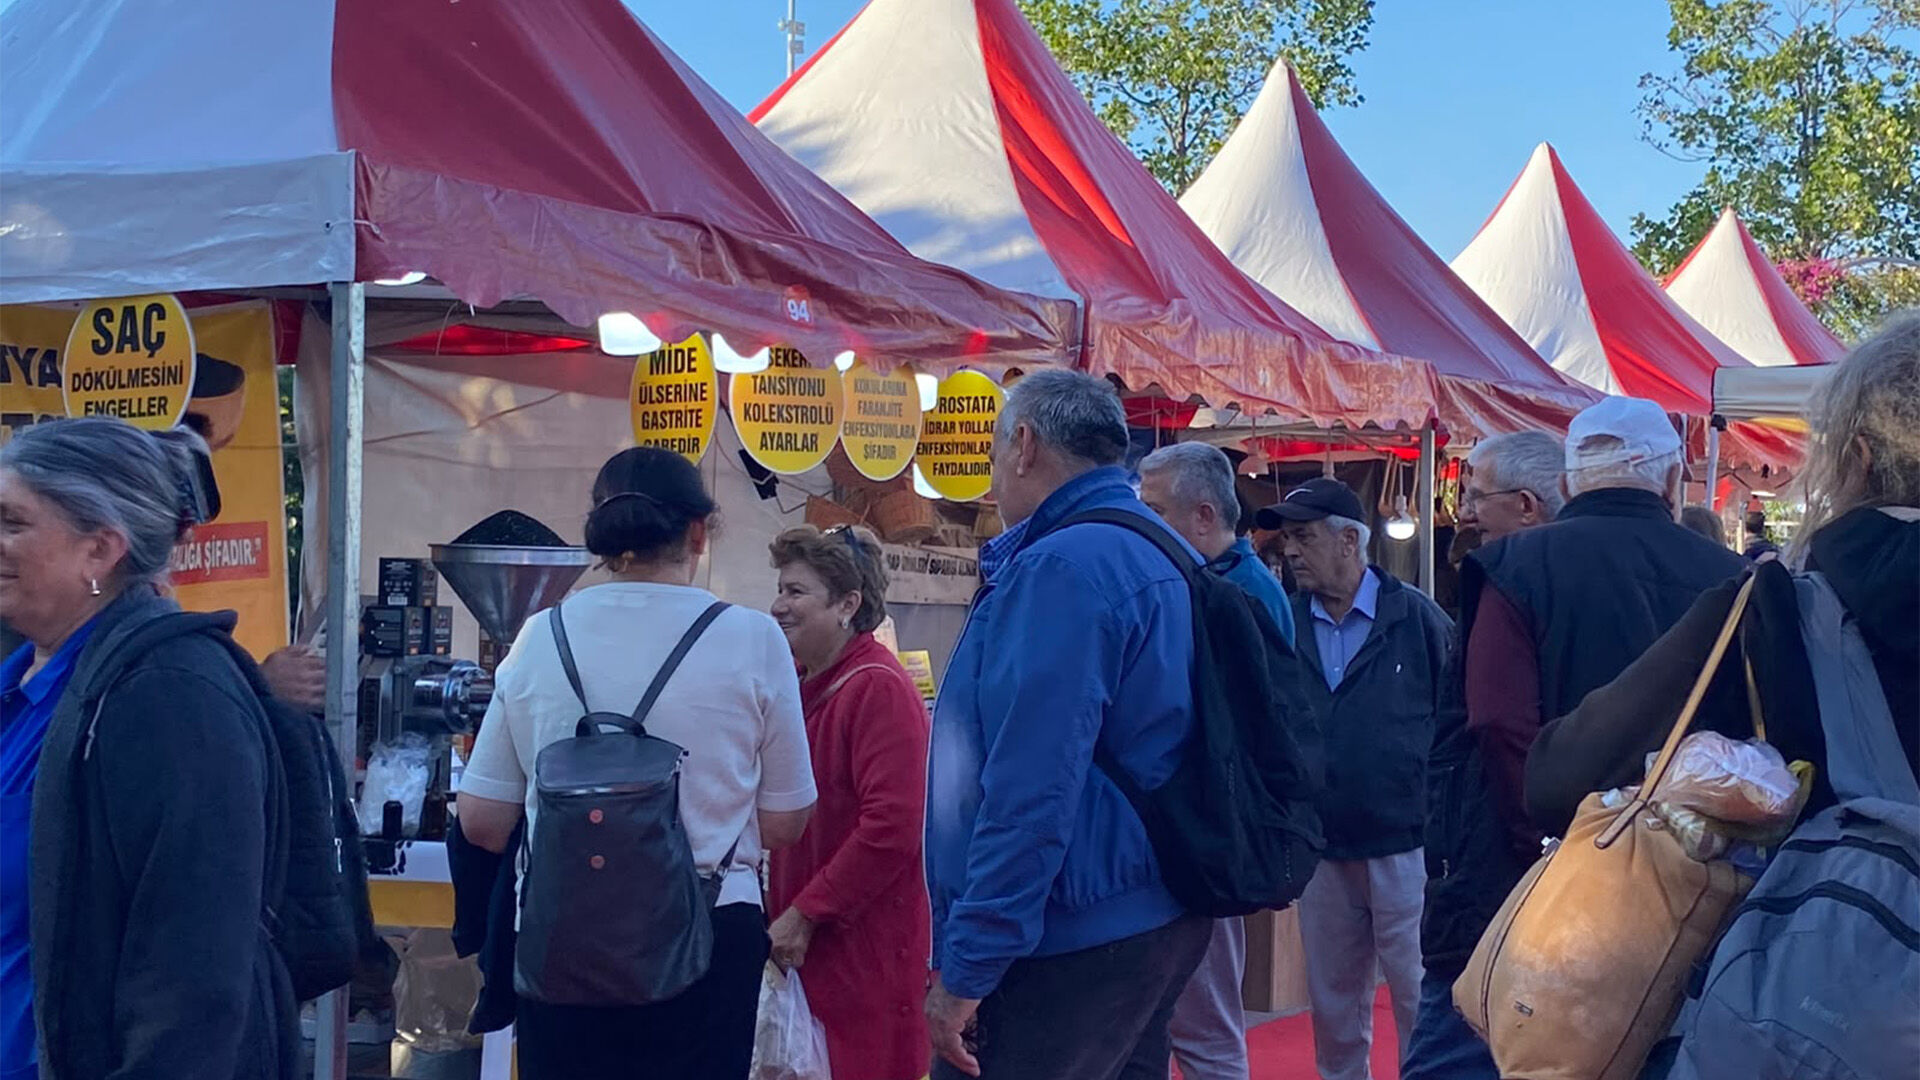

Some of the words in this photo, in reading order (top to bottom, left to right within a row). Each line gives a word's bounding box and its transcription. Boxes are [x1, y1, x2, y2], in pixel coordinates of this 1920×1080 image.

[787, 299, 809, 322] 94
[91, 303, 166, 358] SAÇ
[649, 343, 697, 375] MİDE
[71, 360, 184, 393] DÖKÜLMESİNİ
[751, 372, 826, 397] TANSİYONU
[638, 379, 708, 405] ÜLSERİNE
[84, 396, 168, 418] ENGELLER
[743, 402, 834, 425] KOLEKSTROLÜ
[929, 395, 996, 414] ROSTATA
[641, 405, 703, 430] GASTRİTE
[924, 418, 956, 435] İDRAR
[759, 431, 819, 452] AYARLAR
[932, 461, 992, 476] FAYDALIDIR
